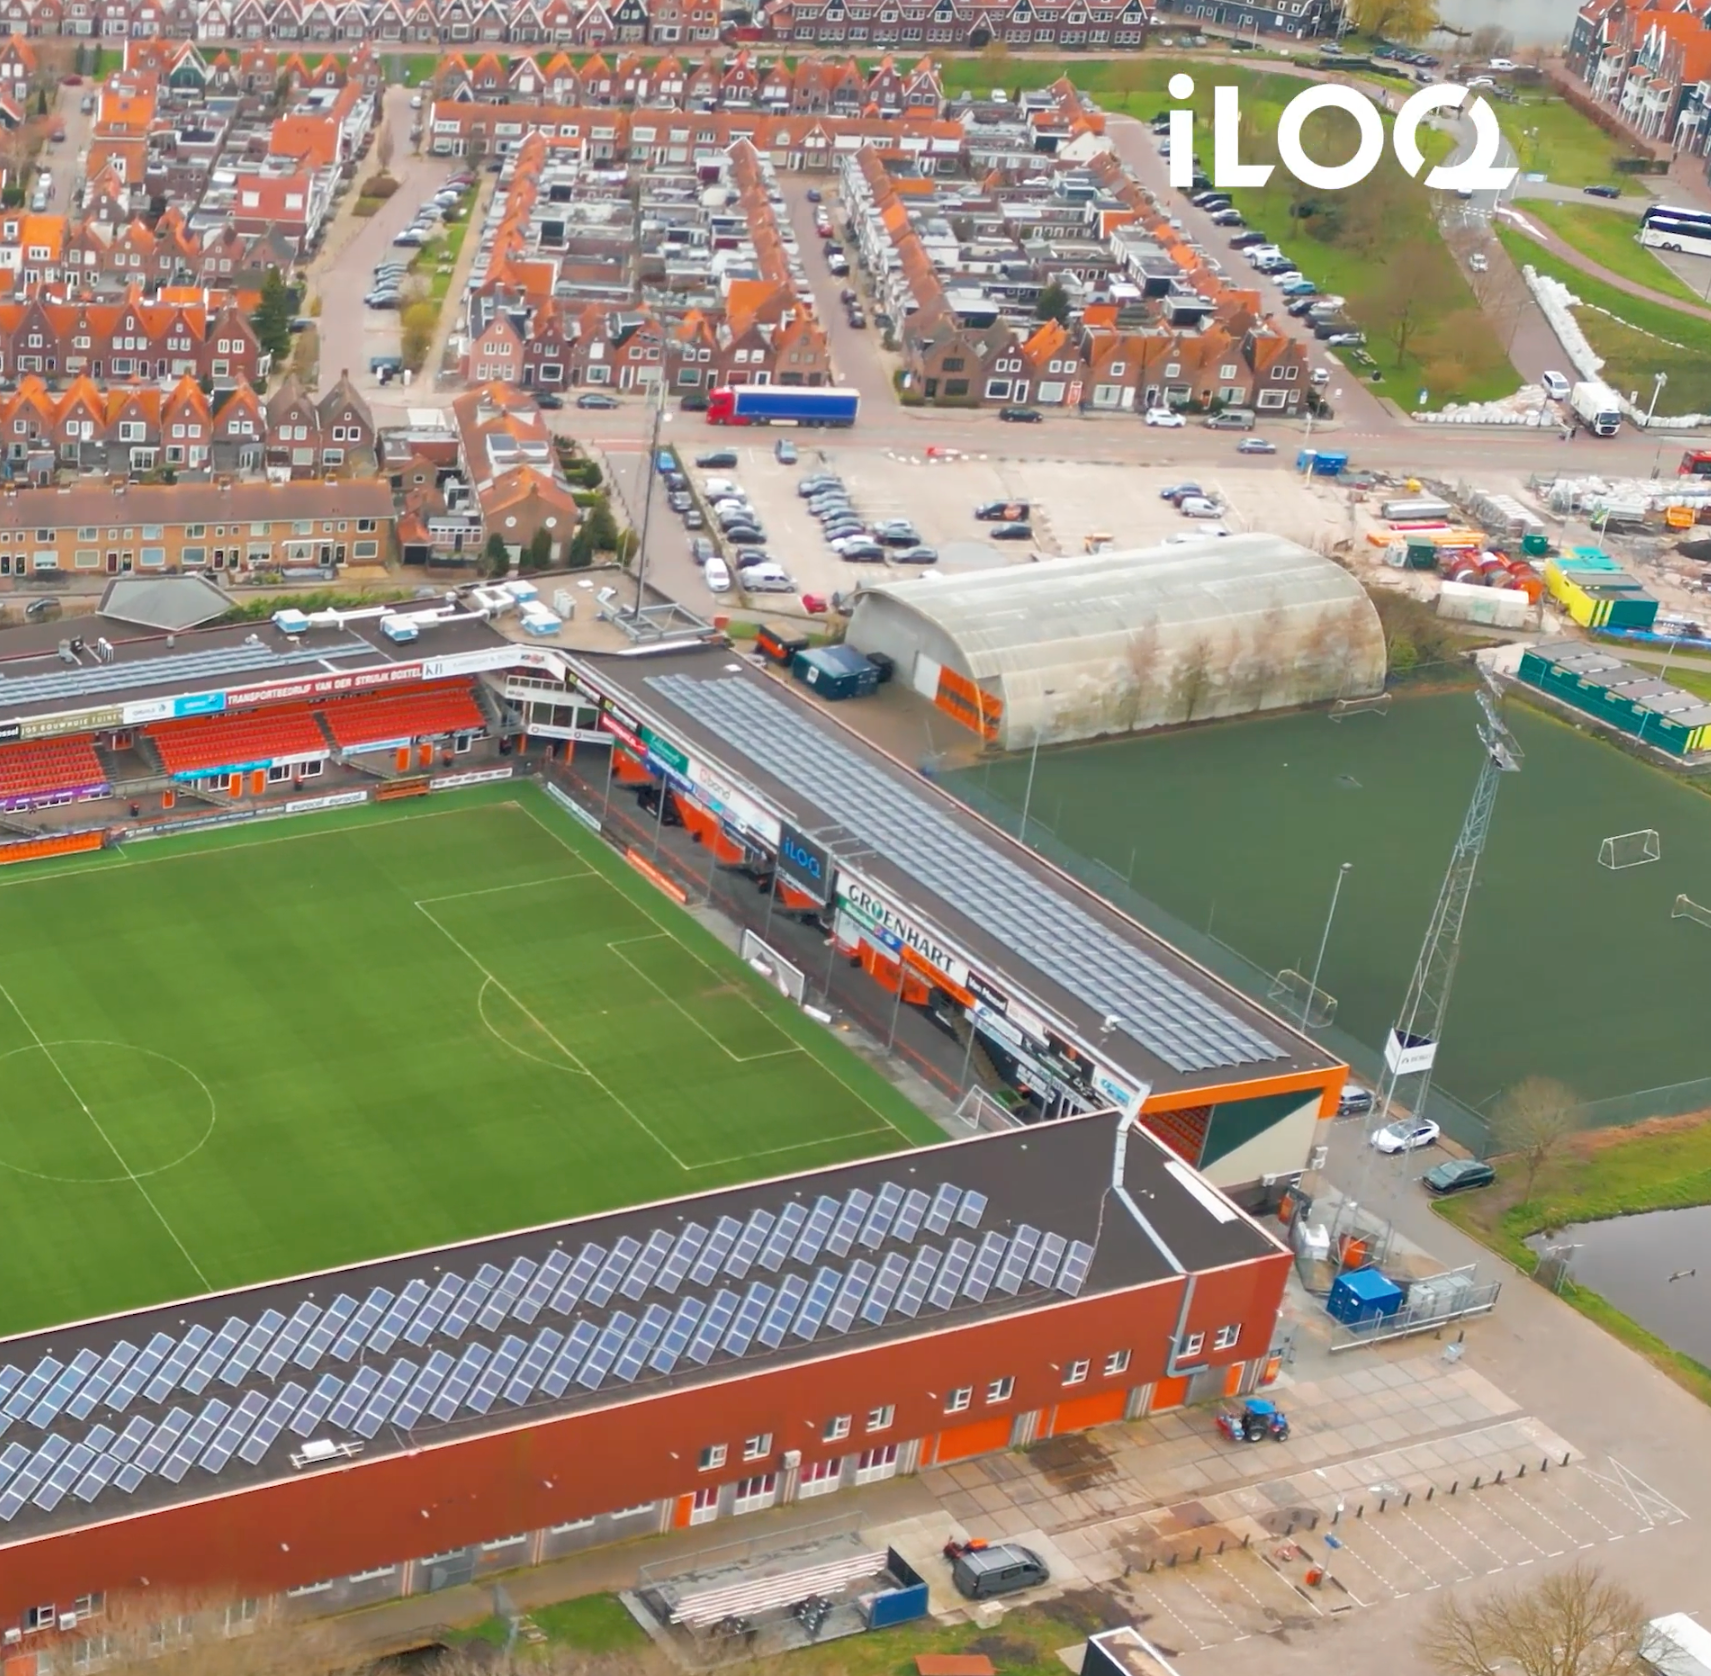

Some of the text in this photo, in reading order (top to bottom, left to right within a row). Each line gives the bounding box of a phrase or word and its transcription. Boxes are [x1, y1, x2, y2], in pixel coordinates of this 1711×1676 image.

[228, 684, 312, 705] TRANSPORTBEDRIJF
[315, 678, 332, 692] VAN
[334, 675, 352, 689] DER
[784, 836, 821, 879] iLOQ
[849, 884, 956, 973] GROENHART
